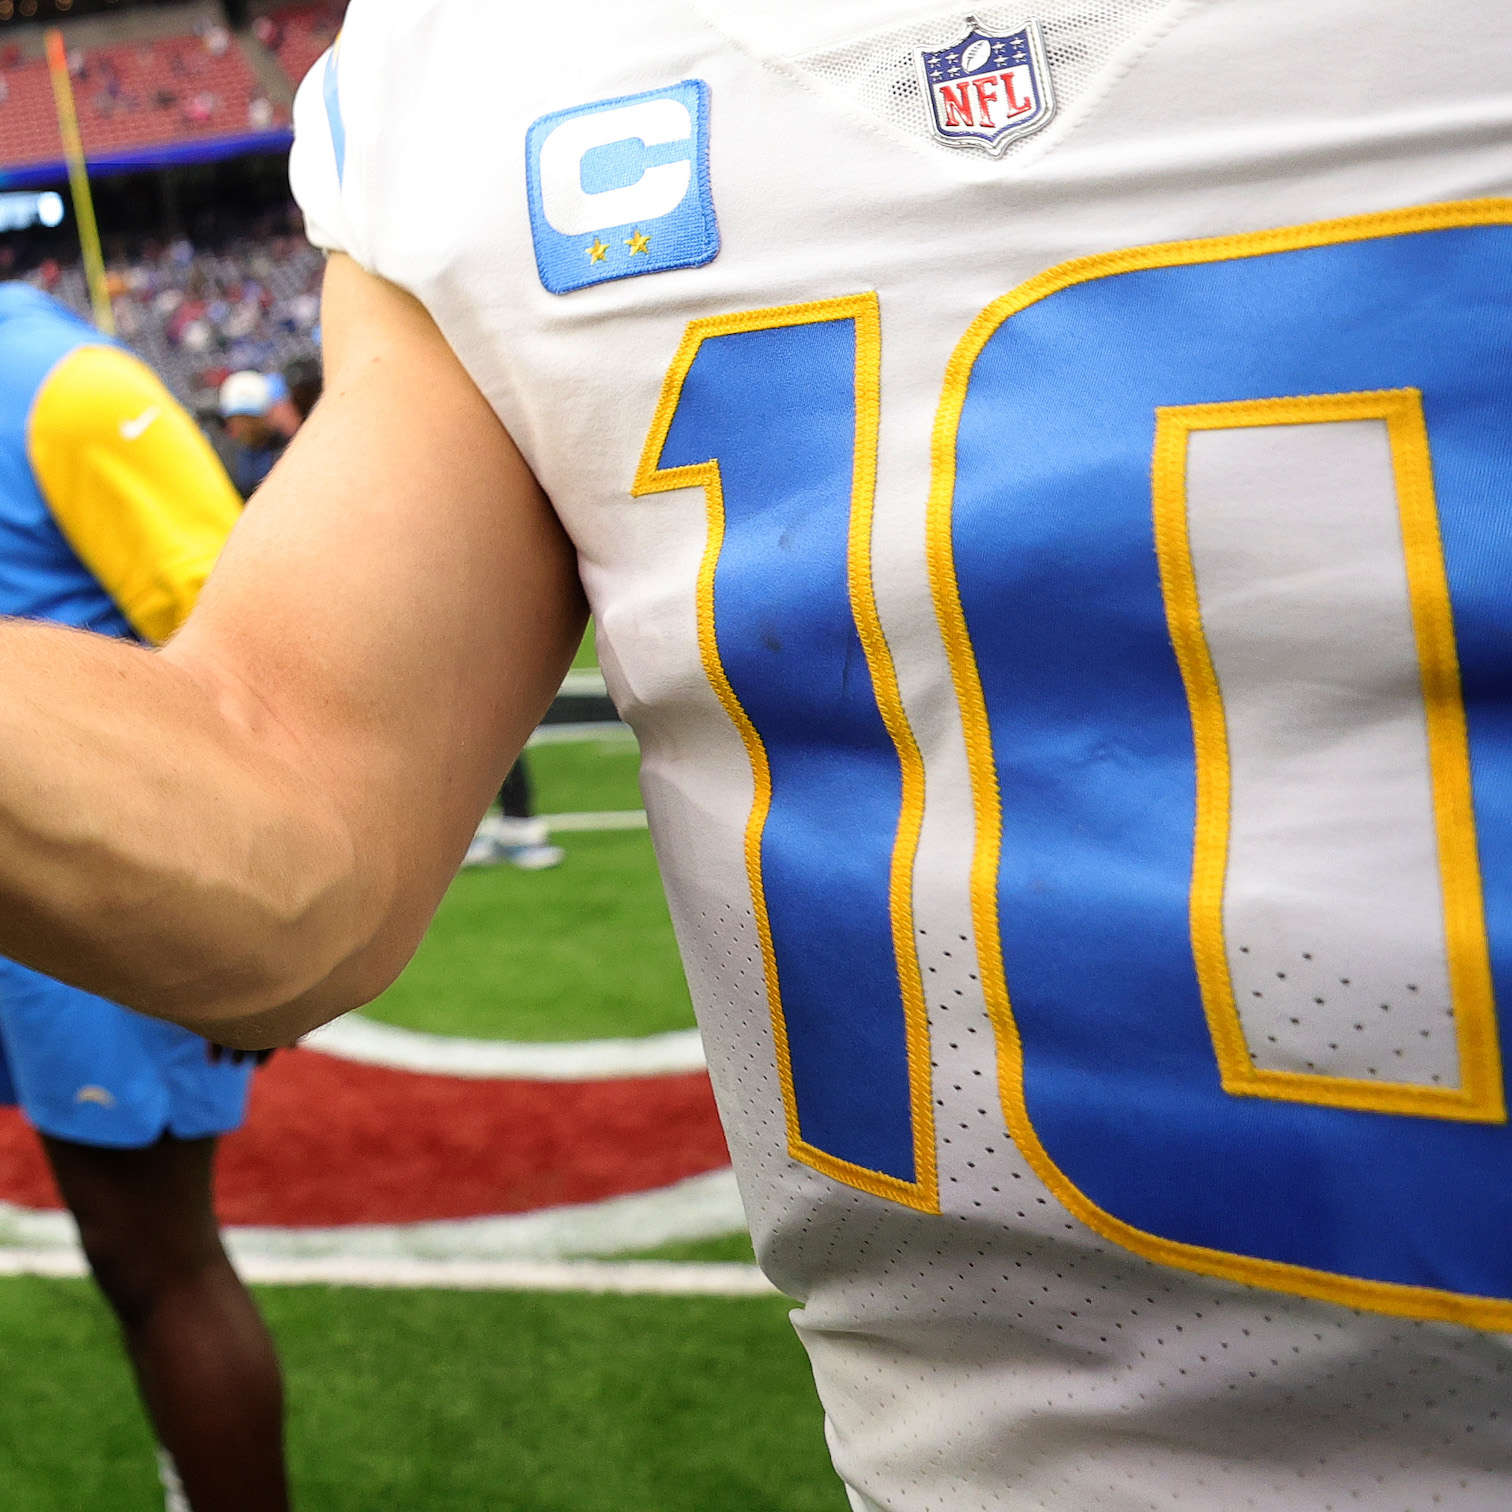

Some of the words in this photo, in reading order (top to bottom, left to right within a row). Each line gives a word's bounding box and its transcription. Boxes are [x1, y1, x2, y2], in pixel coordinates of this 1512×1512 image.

[539, 97, 692, 237] C
[937, 72, 1033, 130] NFL
[630, 197, 1512, 1332] 10
